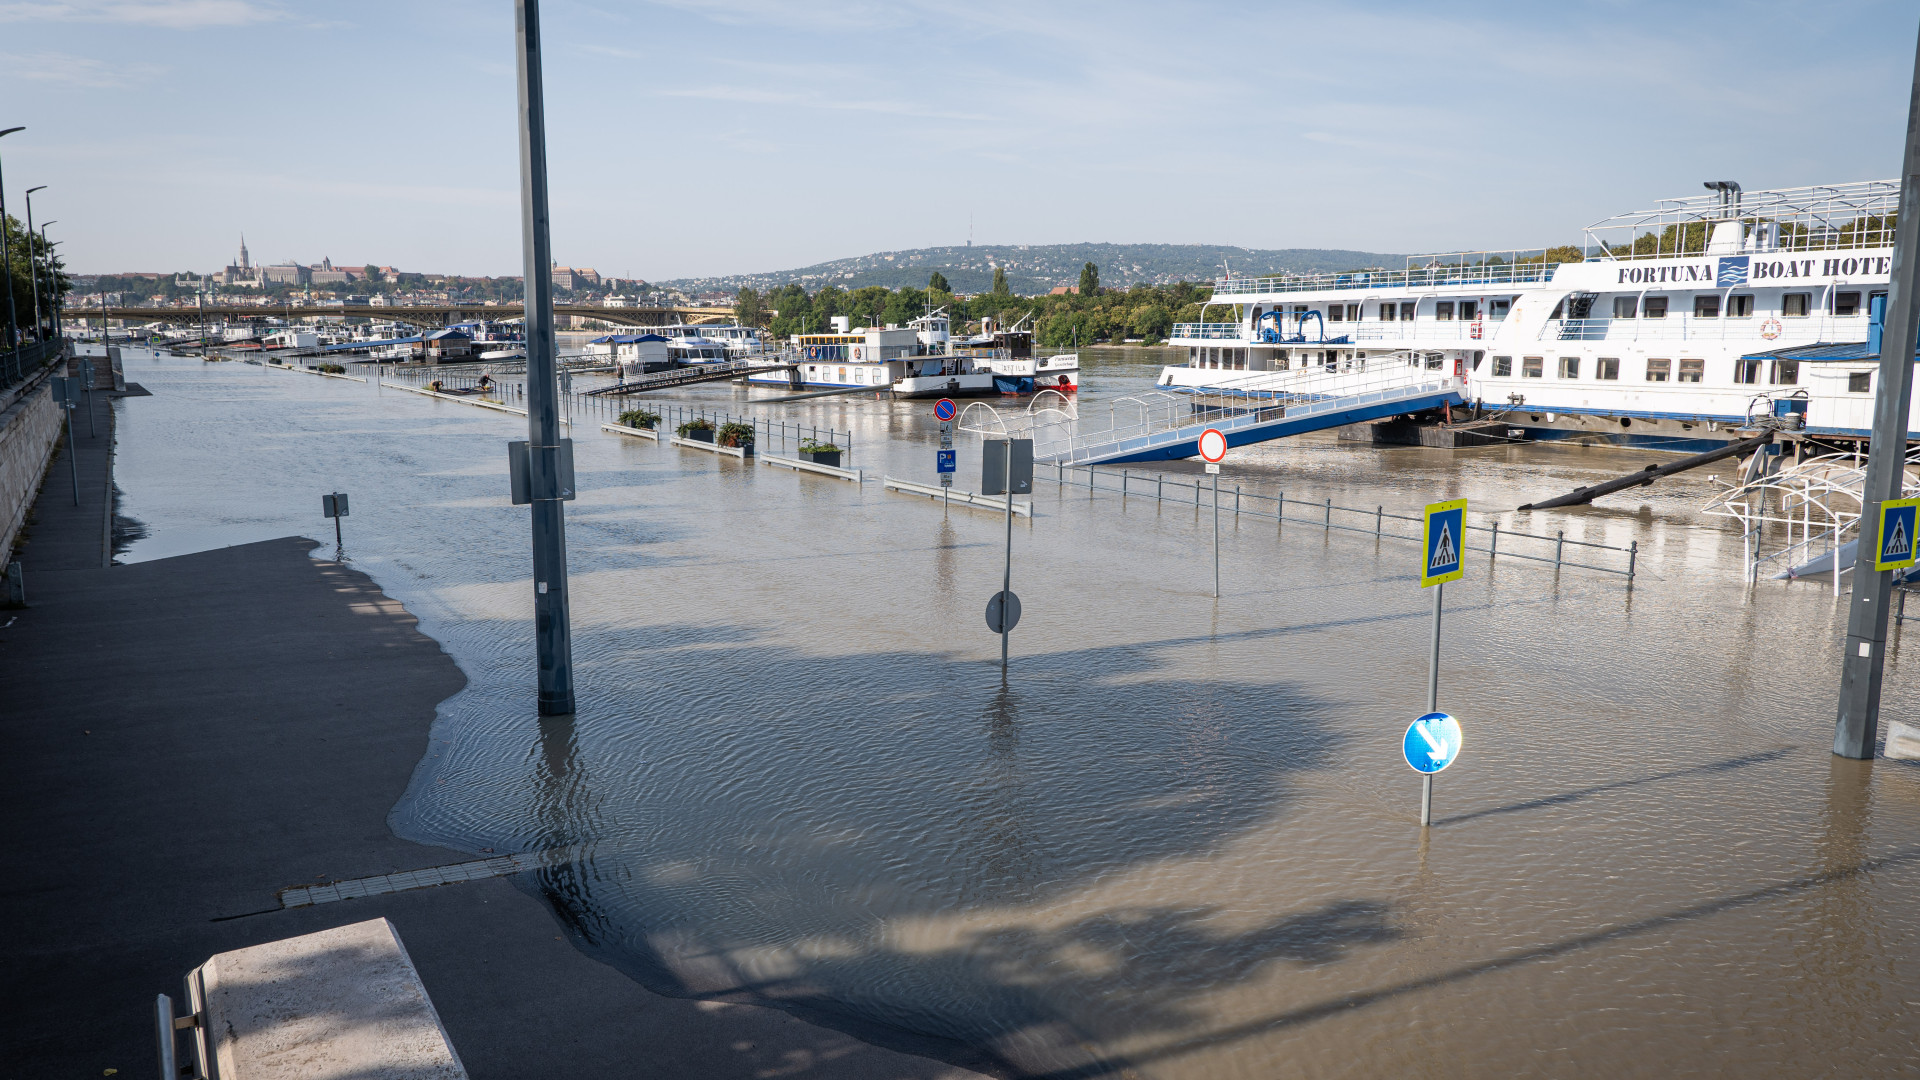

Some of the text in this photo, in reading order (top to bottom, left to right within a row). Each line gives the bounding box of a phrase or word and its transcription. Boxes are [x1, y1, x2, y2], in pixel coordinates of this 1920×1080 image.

[1618, 256, 1891, 283] FORTUNA BOAT HOTE
[1003, 364, 1027, 372] ATTILA
[939, 453, 947, 464] P
